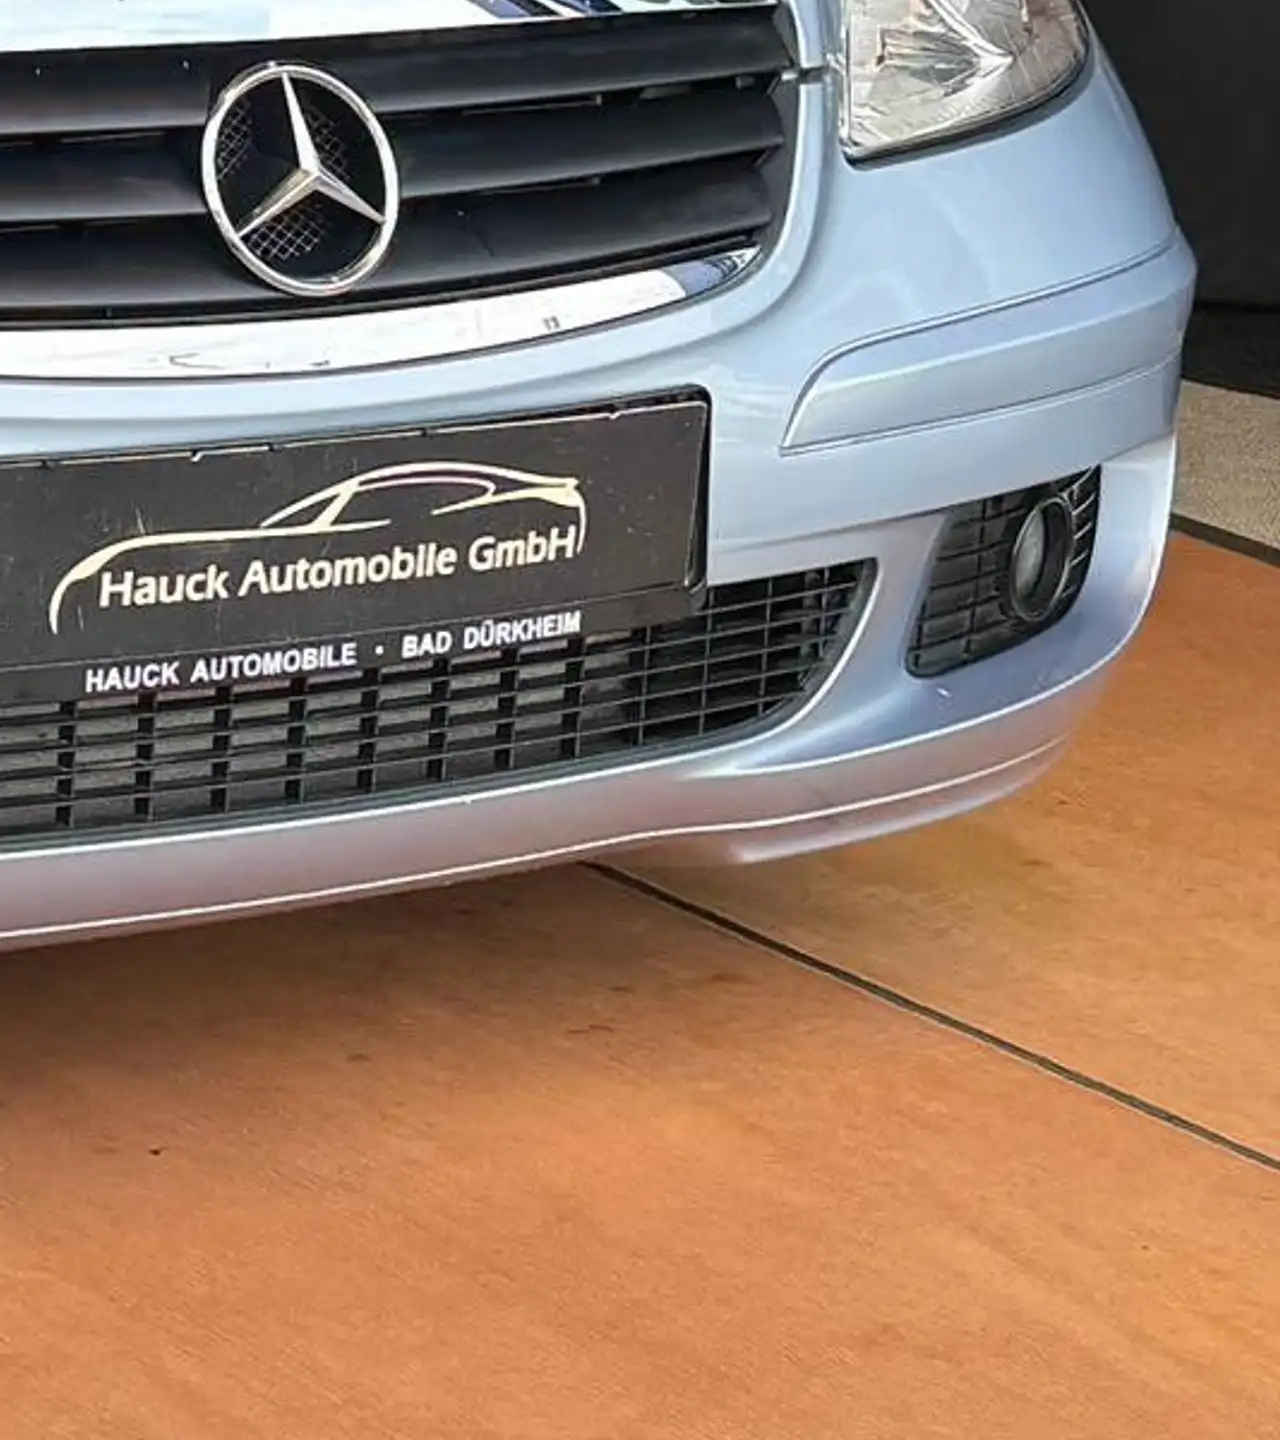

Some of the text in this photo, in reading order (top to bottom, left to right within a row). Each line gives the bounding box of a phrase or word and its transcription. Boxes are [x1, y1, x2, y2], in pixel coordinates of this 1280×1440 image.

[99, 524, 577, 607] Hauck Automobile GmbH
[85, 610, 581, 692] HAUCK AUTOMOBILE BAD DÜRKHEIM
